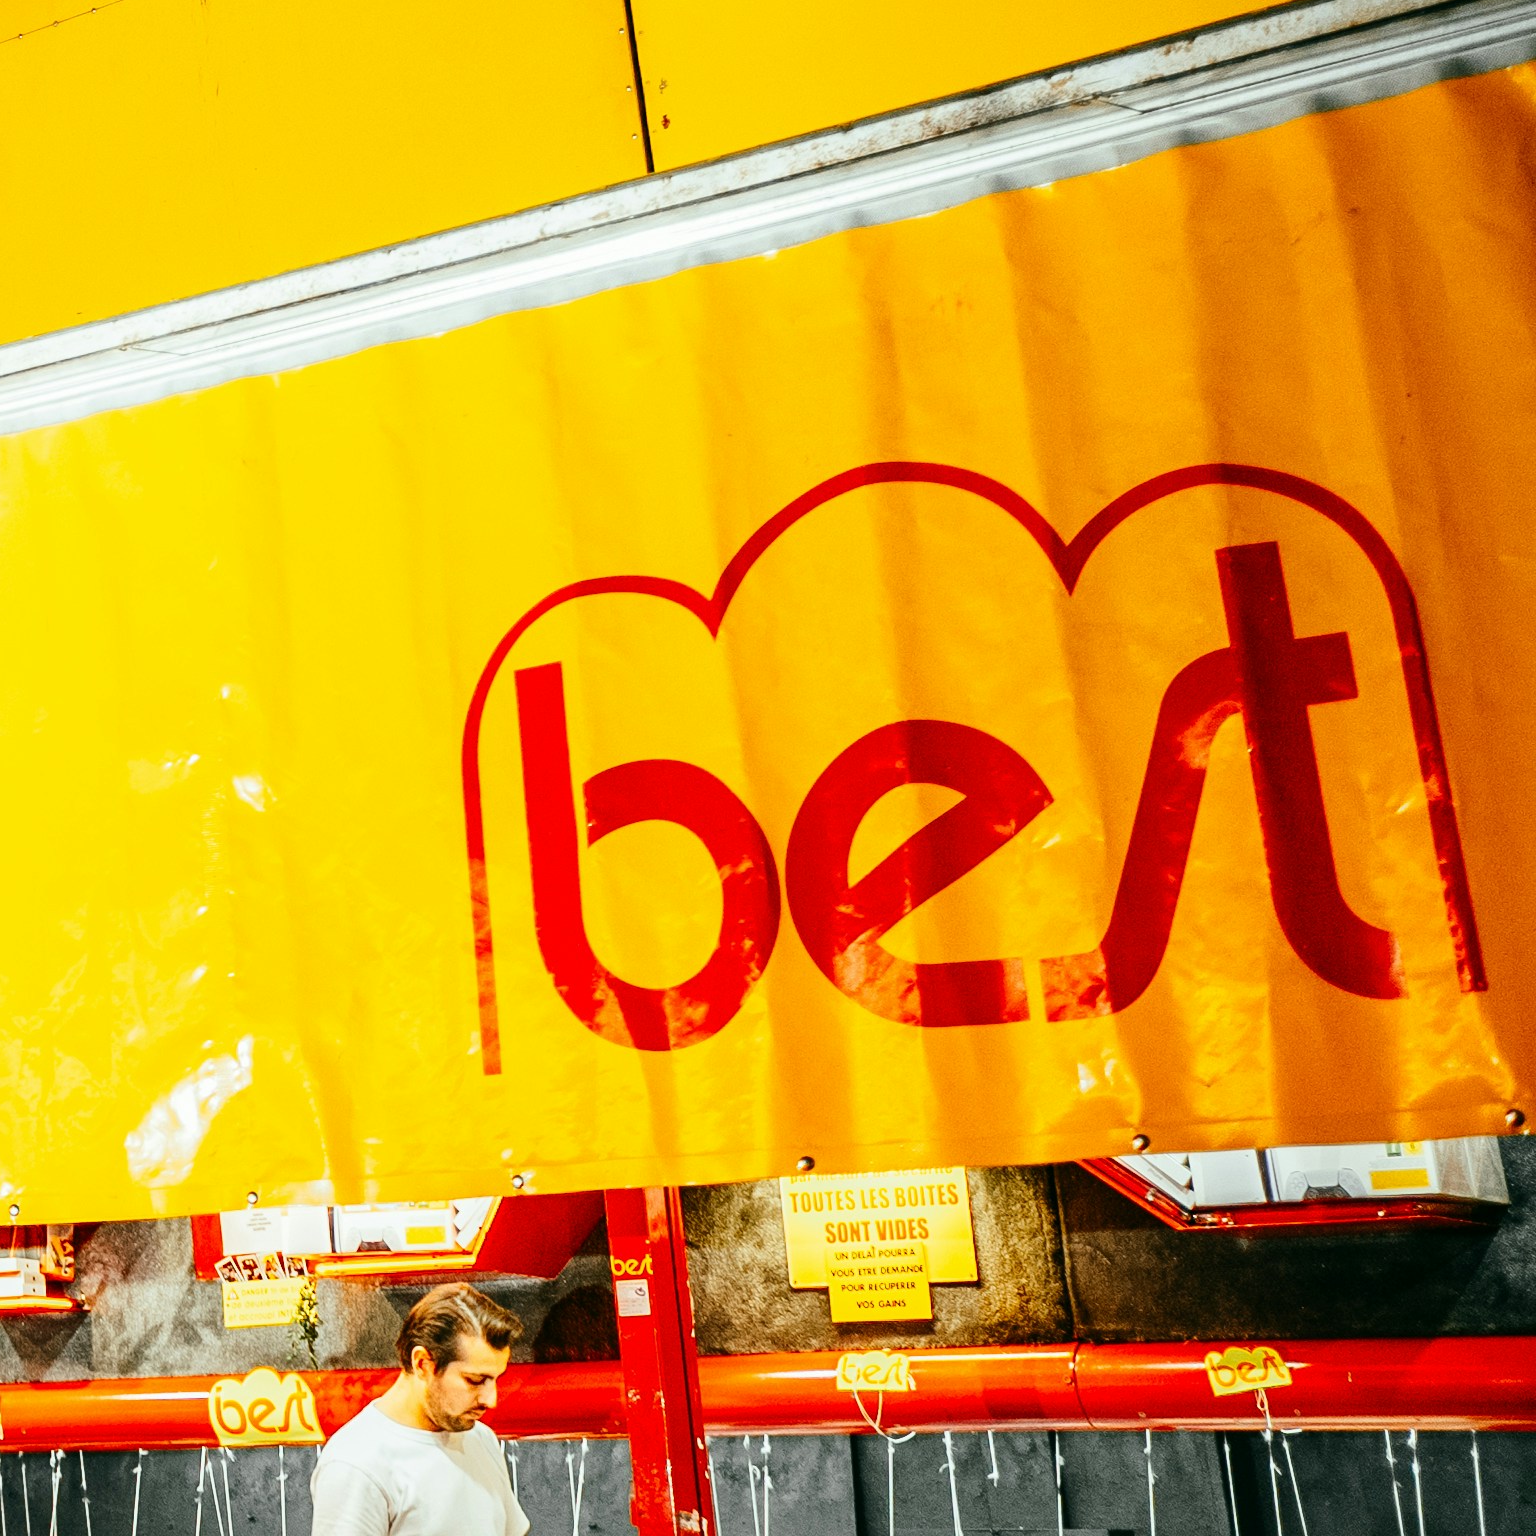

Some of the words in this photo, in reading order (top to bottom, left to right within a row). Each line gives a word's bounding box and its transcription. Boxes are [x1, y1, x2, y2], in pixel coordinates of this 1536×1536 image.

[514, 541, 1409, 1052] best
[789, 1189, 856, 1213] TOUTES
[860, 1187, 890, 1209] LES
[895, 1183, 959, 1207] BOITES
[825, 1220, 871, 1243] SONT
[874, 1218, 929, 1241] VIDES
[610, 1253, 653, 1276] best
[835, 1251, 849, 1260] UN
[878, 1248, 915, 1259] POURRA
[830, 1268, 855, 1278] VOUS
[858, 1267, 877, 1276] ETRE
[880, 1264, 924, 1275] DEMANDE
[841, 1283, 865, 1292] POUR
[868, 1281, 916, 1291] RECUPERER
[856, 1300, 875, 1309] VOS
[878, 1299, 907, 1308] GAINS
[841, 1355, 904, 1386] best
[1208, 1350, 1286, 1389] best
[215, 1379, 315, 1435] best
